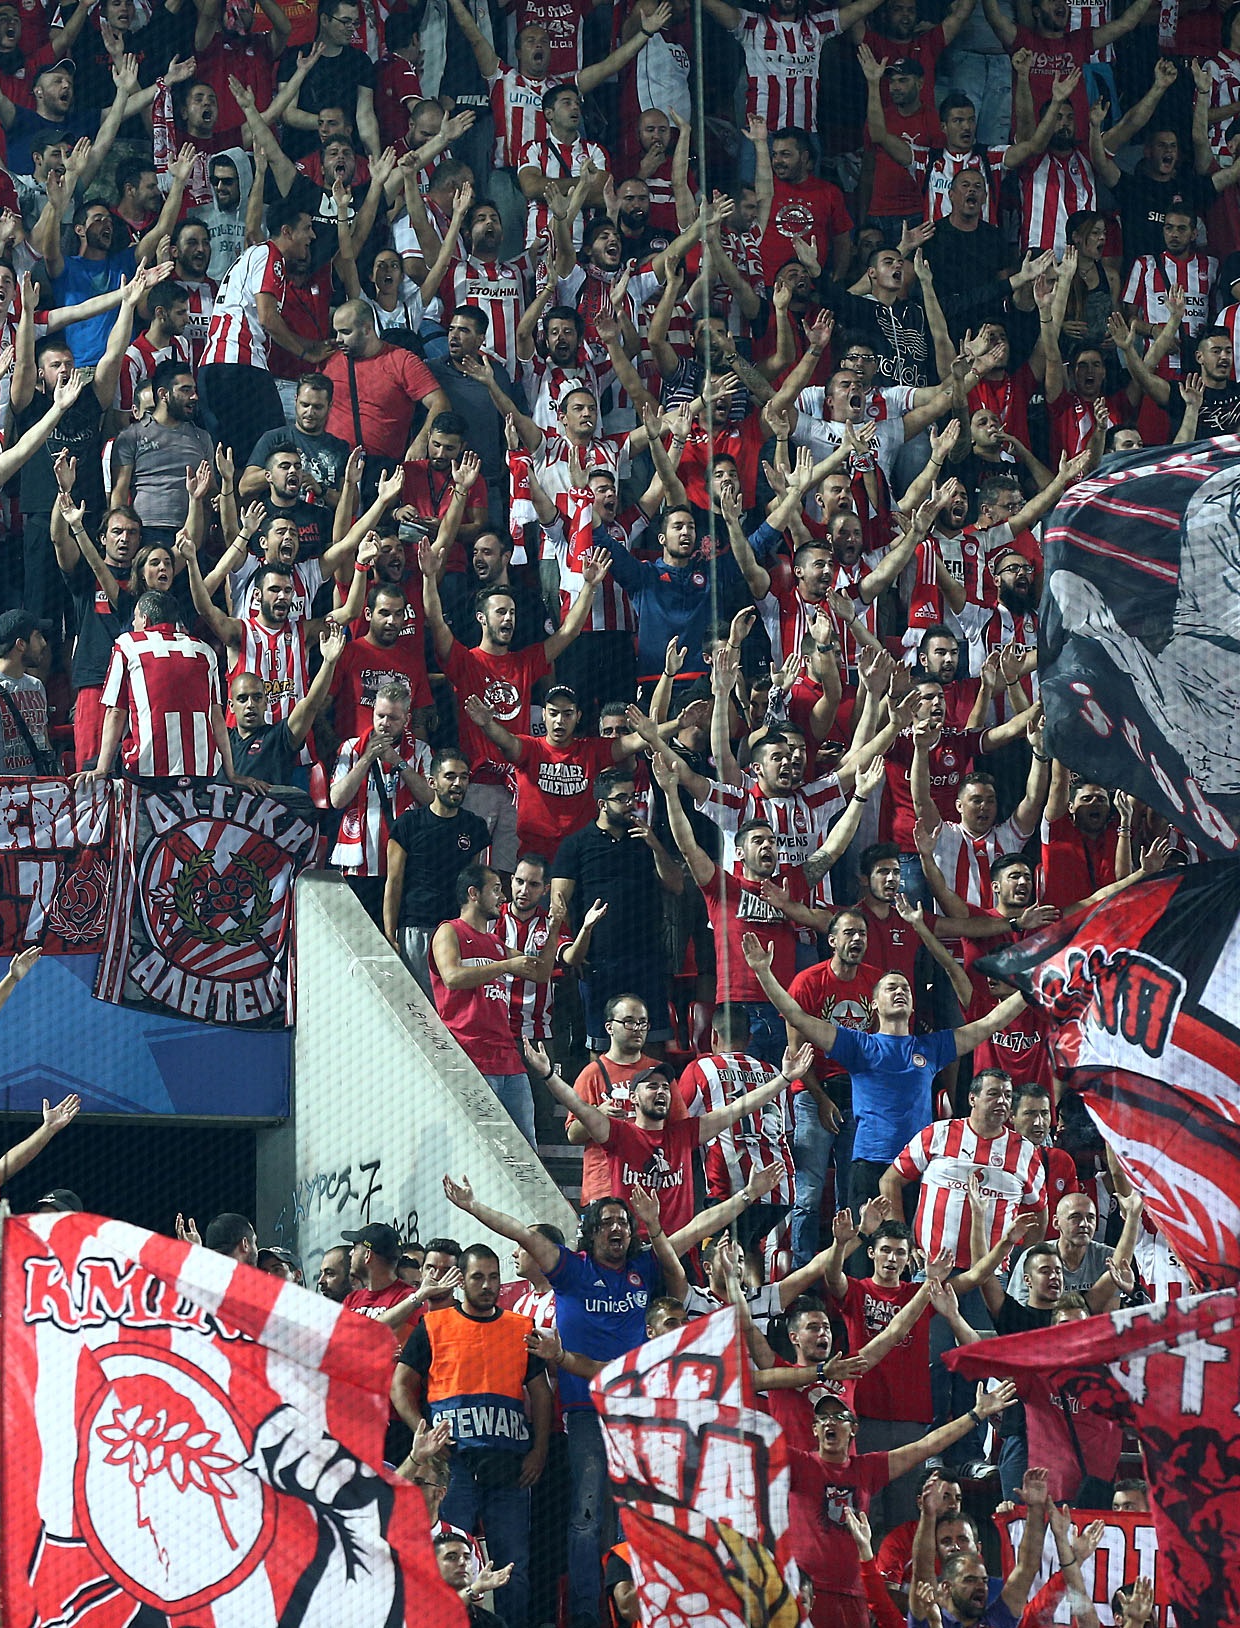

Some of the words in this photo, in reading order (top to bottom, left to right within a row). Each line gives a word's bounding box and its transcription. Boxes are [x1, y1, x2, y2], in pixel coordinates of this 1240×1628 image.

[509, 90, 543, 107] unic
[265, 649, 282, 672] 15
[776, 836, 809, 848] MENS
[17, 859, 58, 943] 7
[584, 1291, 636, 1313] unicef
